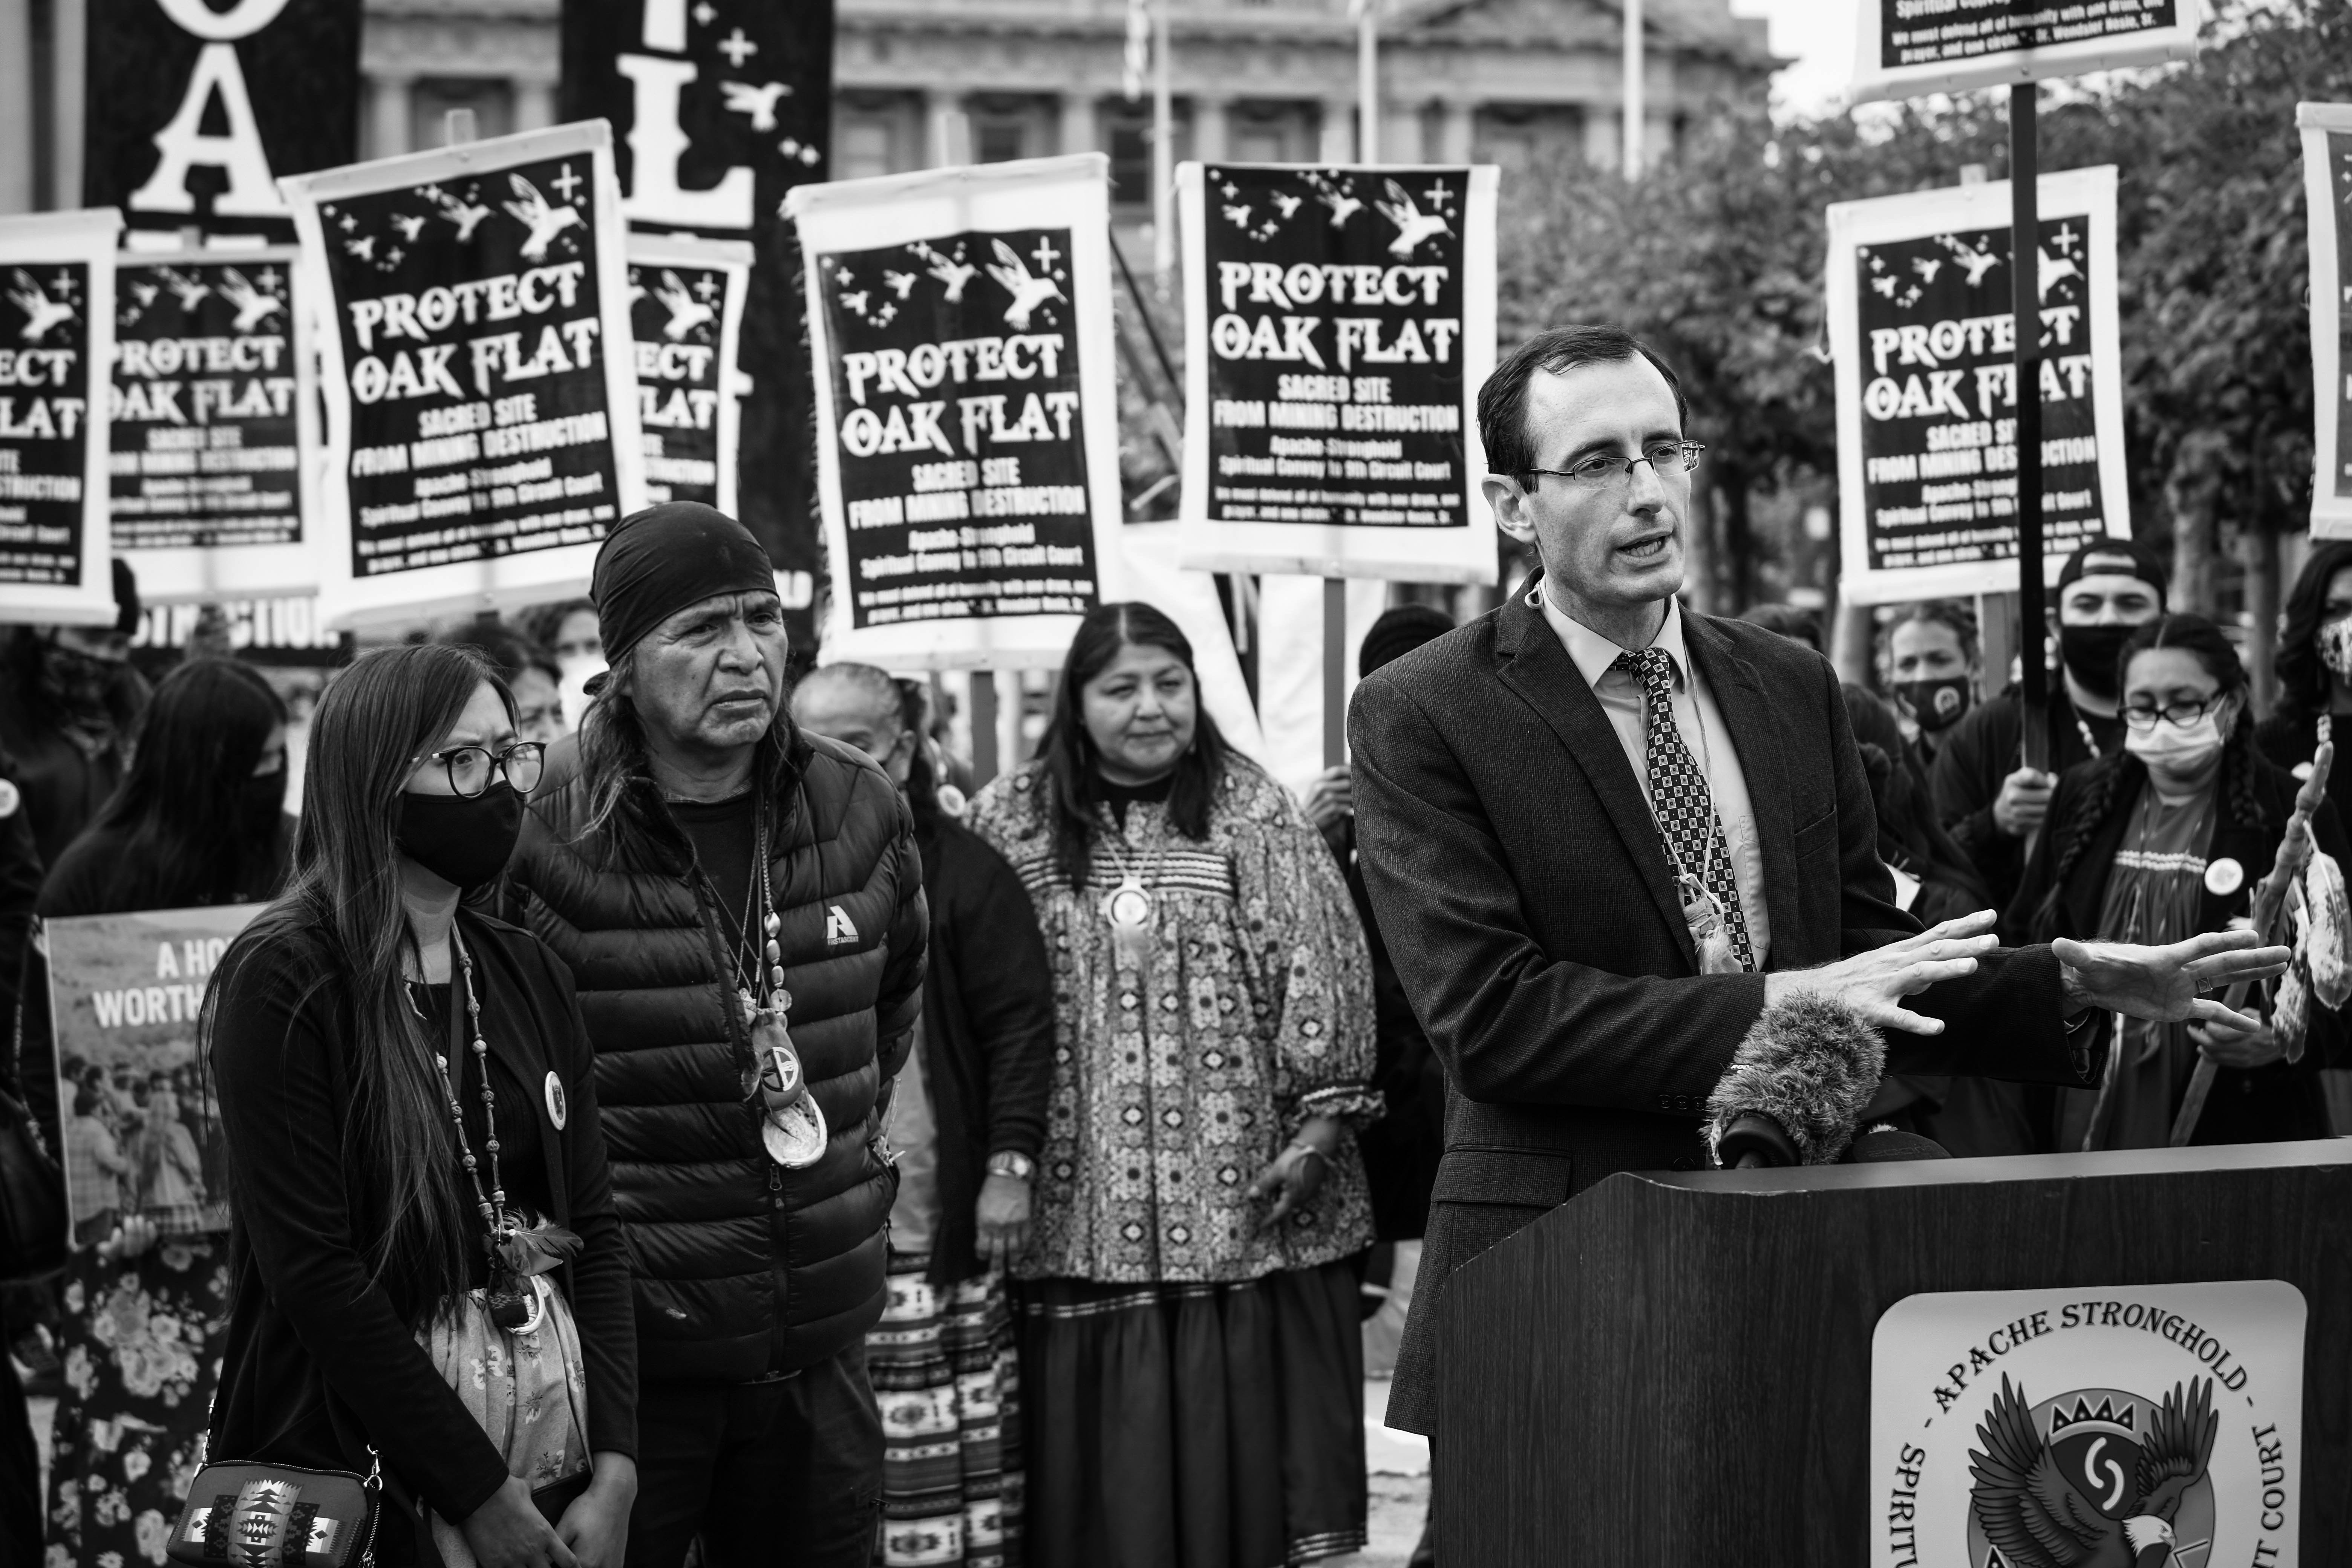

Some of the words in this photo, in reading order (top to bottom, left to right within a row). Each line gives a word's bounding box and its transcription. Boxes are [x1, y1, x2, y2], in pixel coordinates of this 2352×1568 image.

[348, 262, 585, 352] PROTECT
[1217, 261, 1449, 312] PROTECT
[351, 343, 464, 404] OAK
[469, 318, 599, 397] FLAT
[1211, 313, 1326, 370] OAK
[1333, 317, 1460, 373] FLAT
[1869, 305, 2080, 375] PROTET
[841, 334, 1064, 406] PROTECT
[1279, 374, 1350, 403] SACRED
[1354, 377, 1391, 403] SITE
[0, 396, 85, 440] LAT
[190, 378, 296, 426] FLAT
[494, 394, 537, 426] SITE
[640, 384, 717, 429] LAT
[1213, 399, 1265, 427] FROM
[1269, 400, 1337, 429] MINING
[1340, 400, 1459, 432] DESTRUCTION
[1864, 369, 1970, 421] OAK
[841, 400, 954, 457] OAK
[956, 391, 1078, 456] FLAT
[1927, 421, 1992, 453] SACRED
[348, 444, 408, 476] FROM
[982, 457, 1021, 489] SITE
[1867, 455, 1917, 484] FROM
[1919, 445, 1981, 478] MINING
[848, 496, 903, 529] FROM
[157, 942, 180, 980] A
[1932, 1310, 2053, 1414] APACHE
[2060, 1301, 2247, 1392] STRONGHOLD
[2251, 1422, 2286, 1530] COURT
